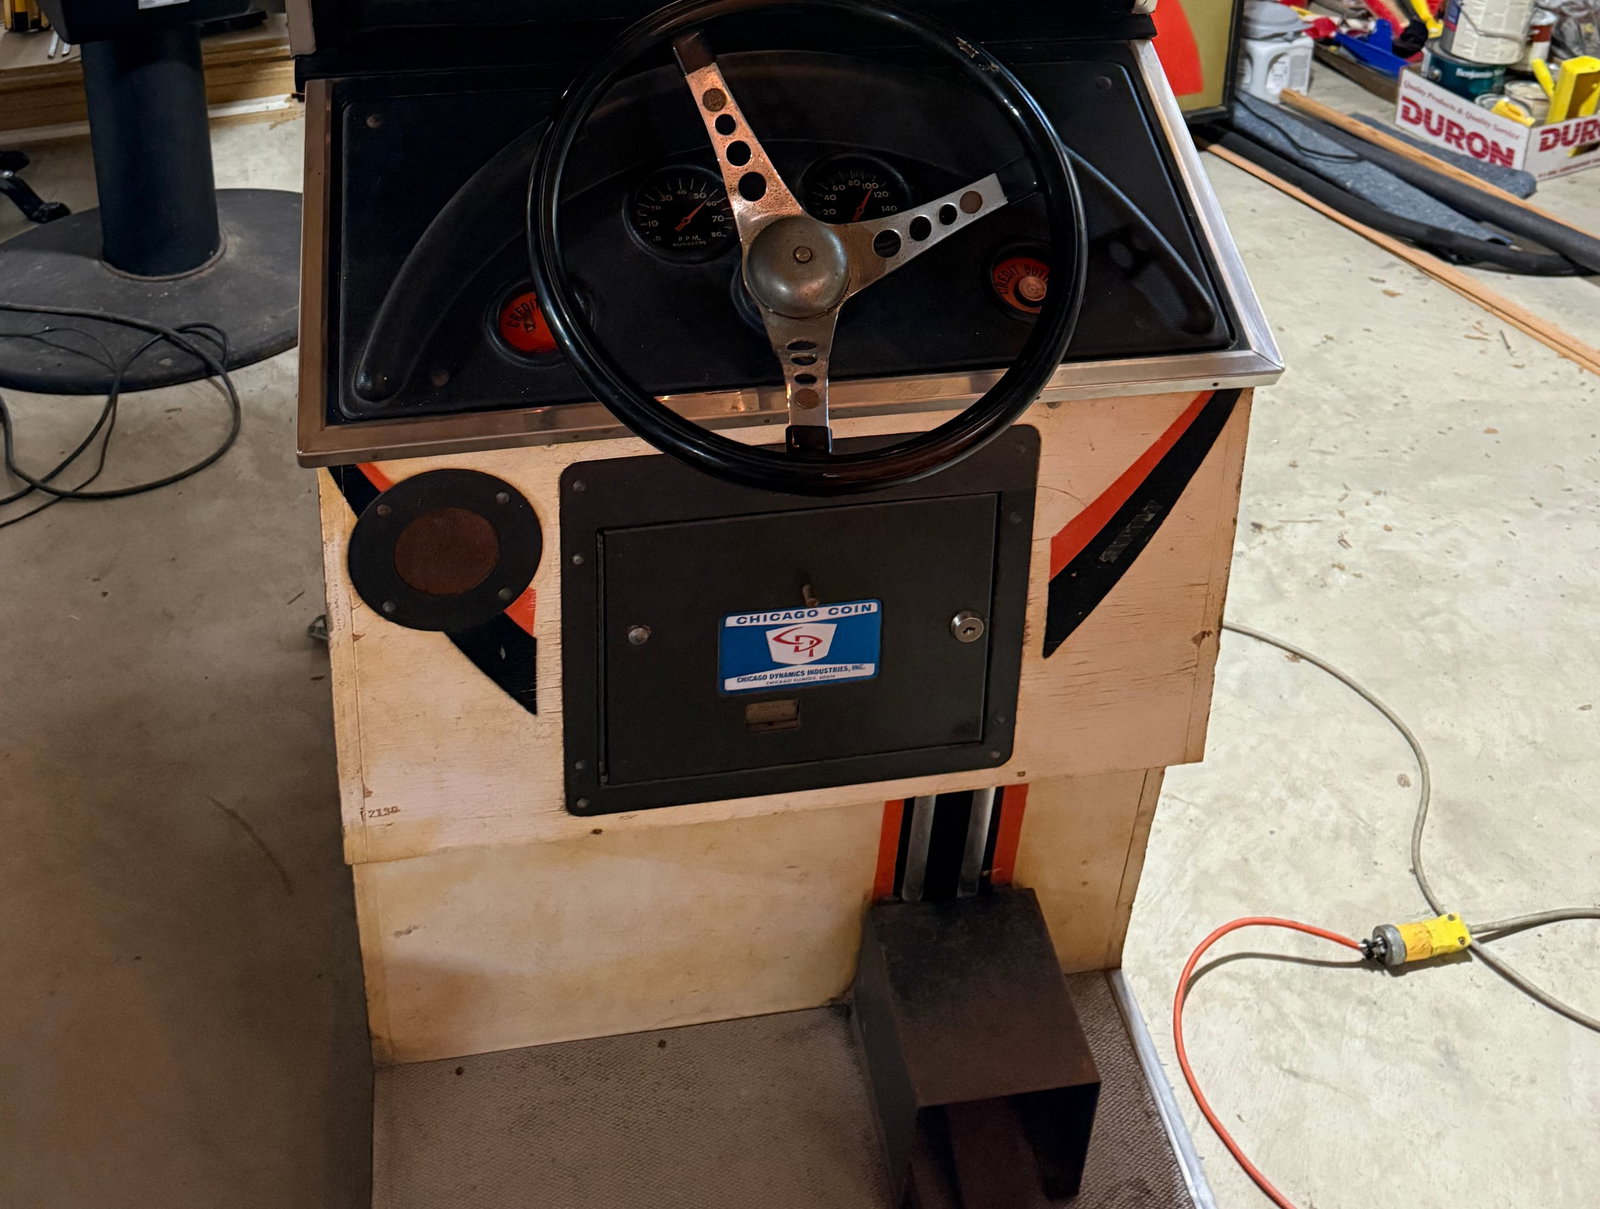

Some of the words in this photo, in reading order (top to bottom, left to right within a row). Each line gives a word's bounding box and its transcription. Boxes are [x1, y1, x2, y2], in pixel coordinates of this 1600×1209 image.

[1401, 95, 1515, 168] DURON
[1538, 118, 1600, 152] DUR
[862, 182, 879, 190] 100
[660, 194, 673, 202] 30
[997, 263, 1020, 295] CREDIT
[736, 608, 819, 625] CHICAGO
[828, 603, 872, 616] COIN
[737, 674, 767, 683] CHICAGO
[769, 670, 805, 680] DYNAMICS
